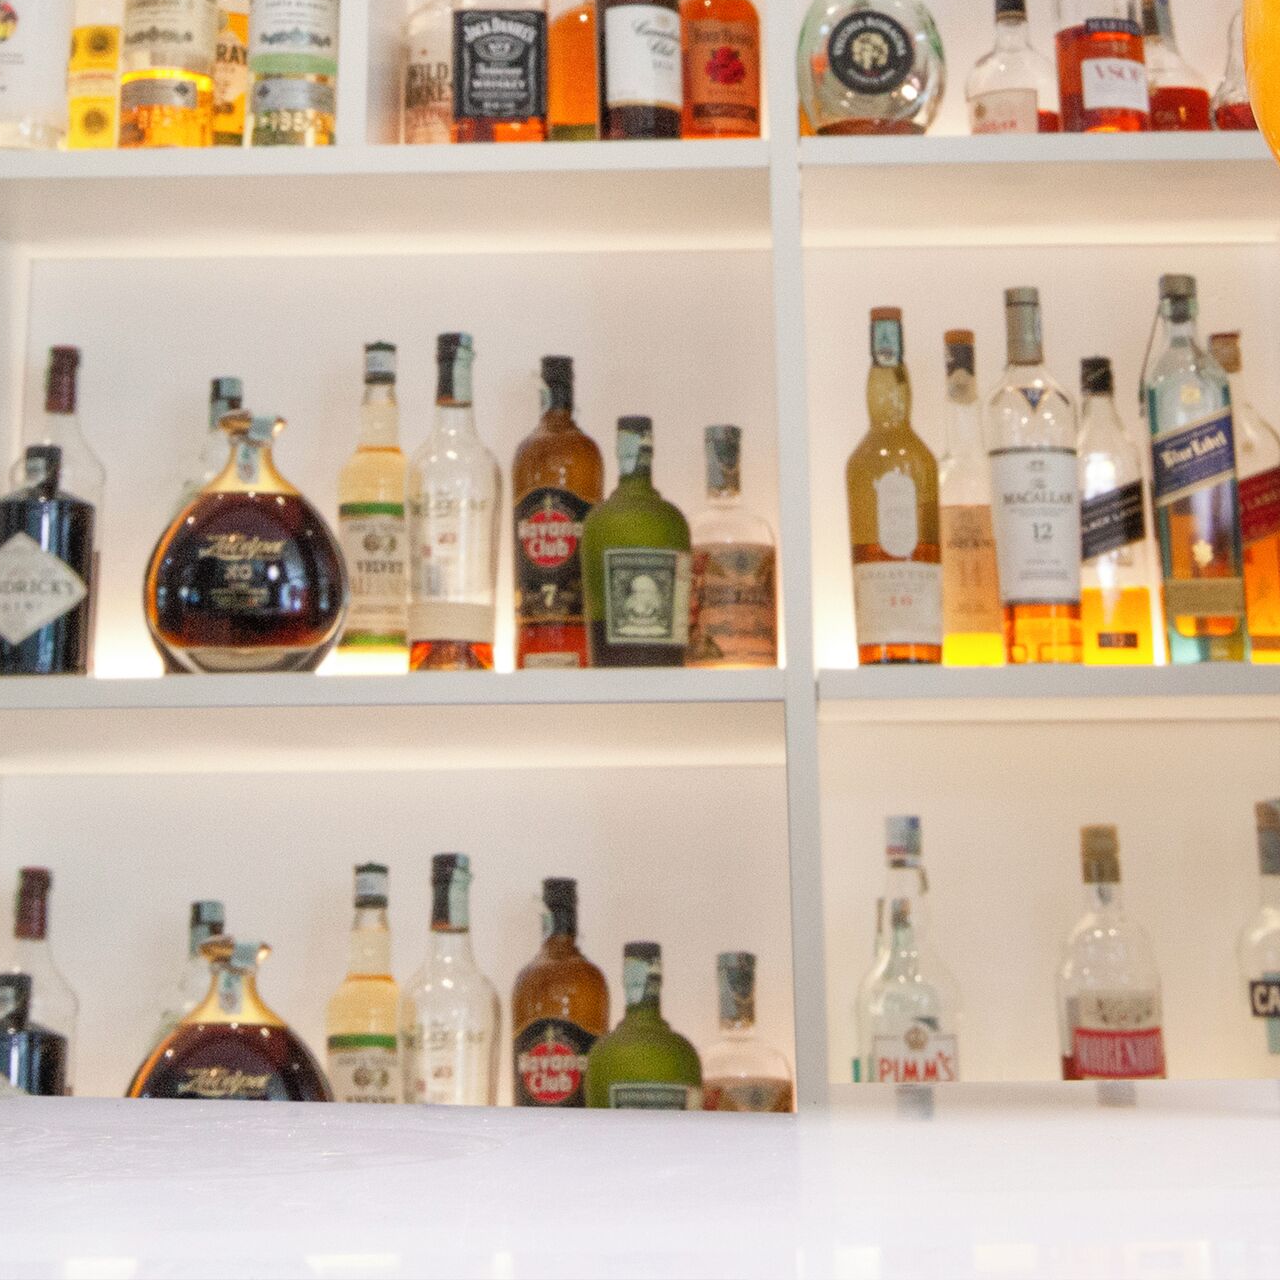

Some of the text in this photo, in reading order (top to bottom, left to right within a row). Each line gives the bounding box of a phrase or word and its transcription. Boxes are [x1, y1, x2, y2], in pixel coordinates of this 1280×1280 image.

[1032, 521, 1054, 540] 12
[540, 583, 557, 608] 7
[878, 1050, 956, 1082] PIMM'S
